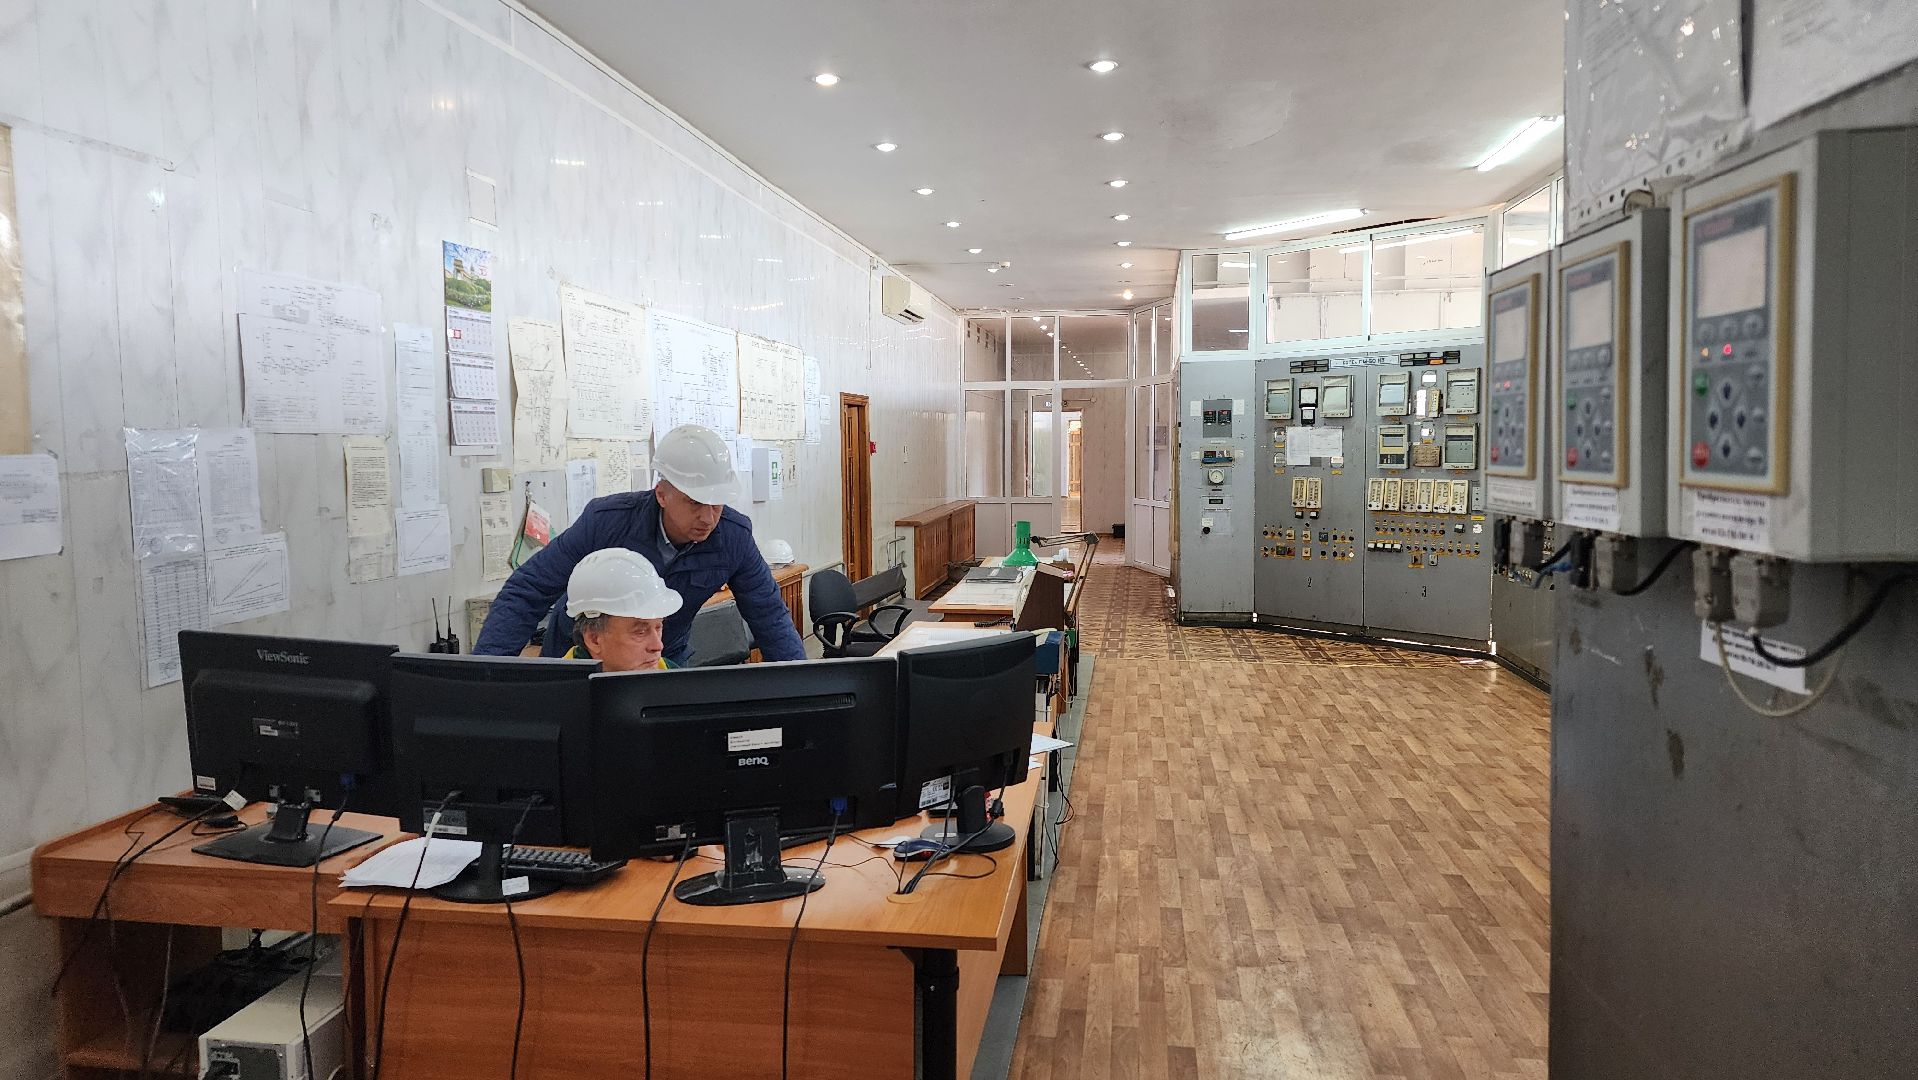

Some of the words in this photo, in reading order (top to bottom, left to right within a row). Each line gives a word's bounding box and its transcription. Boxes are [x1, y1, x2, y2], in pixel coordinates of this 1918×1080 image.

[1306, 577, 1312, 588] 2
[1421, 586, 1427, 597] 3
[256, 648, 310, 664] ViewSonic
[738, 756, 769, 767] BenQ
